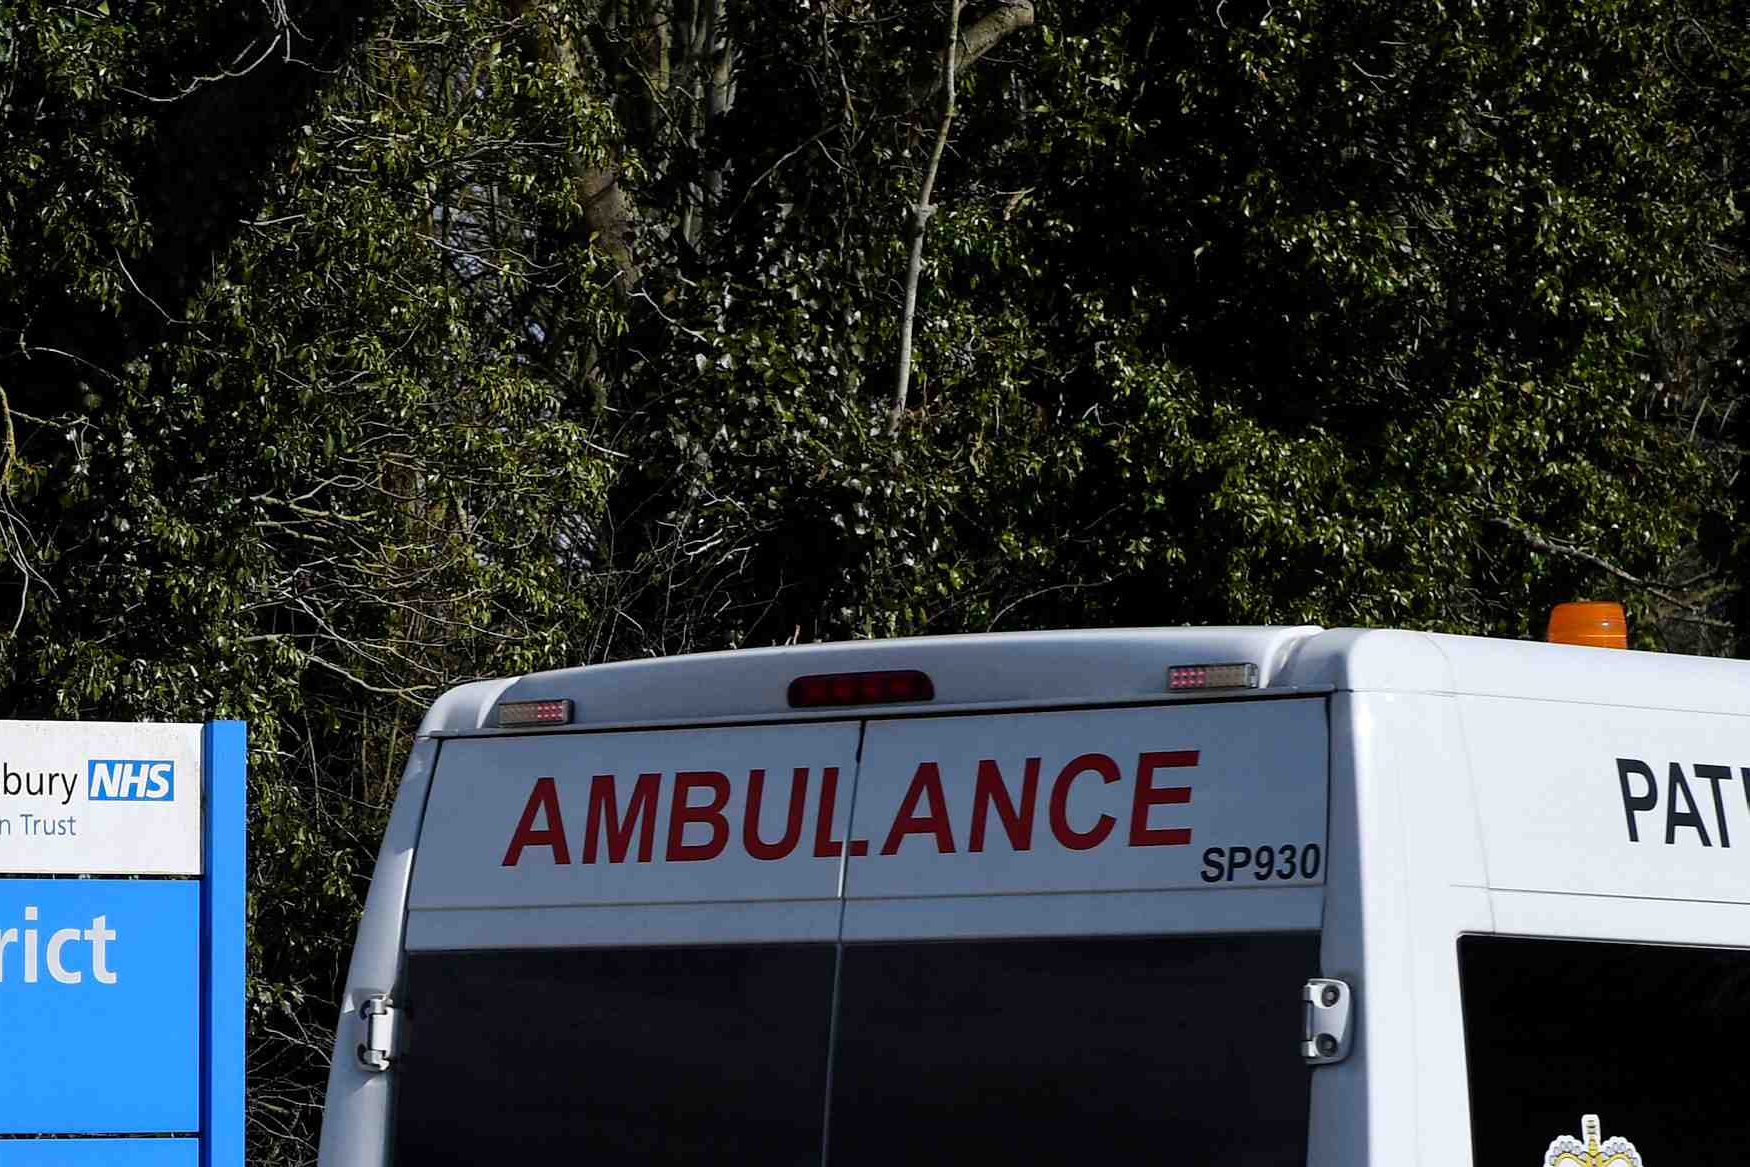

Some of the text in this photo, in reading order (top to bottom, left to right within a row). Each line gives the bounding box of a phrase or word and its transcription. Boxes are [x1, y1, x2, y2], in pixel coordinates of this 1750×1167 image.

[89, 762, 172, 799] NHS
[19, 814, 77, 836] Trust
[502, 750, 1200, 866] AMBULANCE
[1200, 842, 1321, 883] SP930
